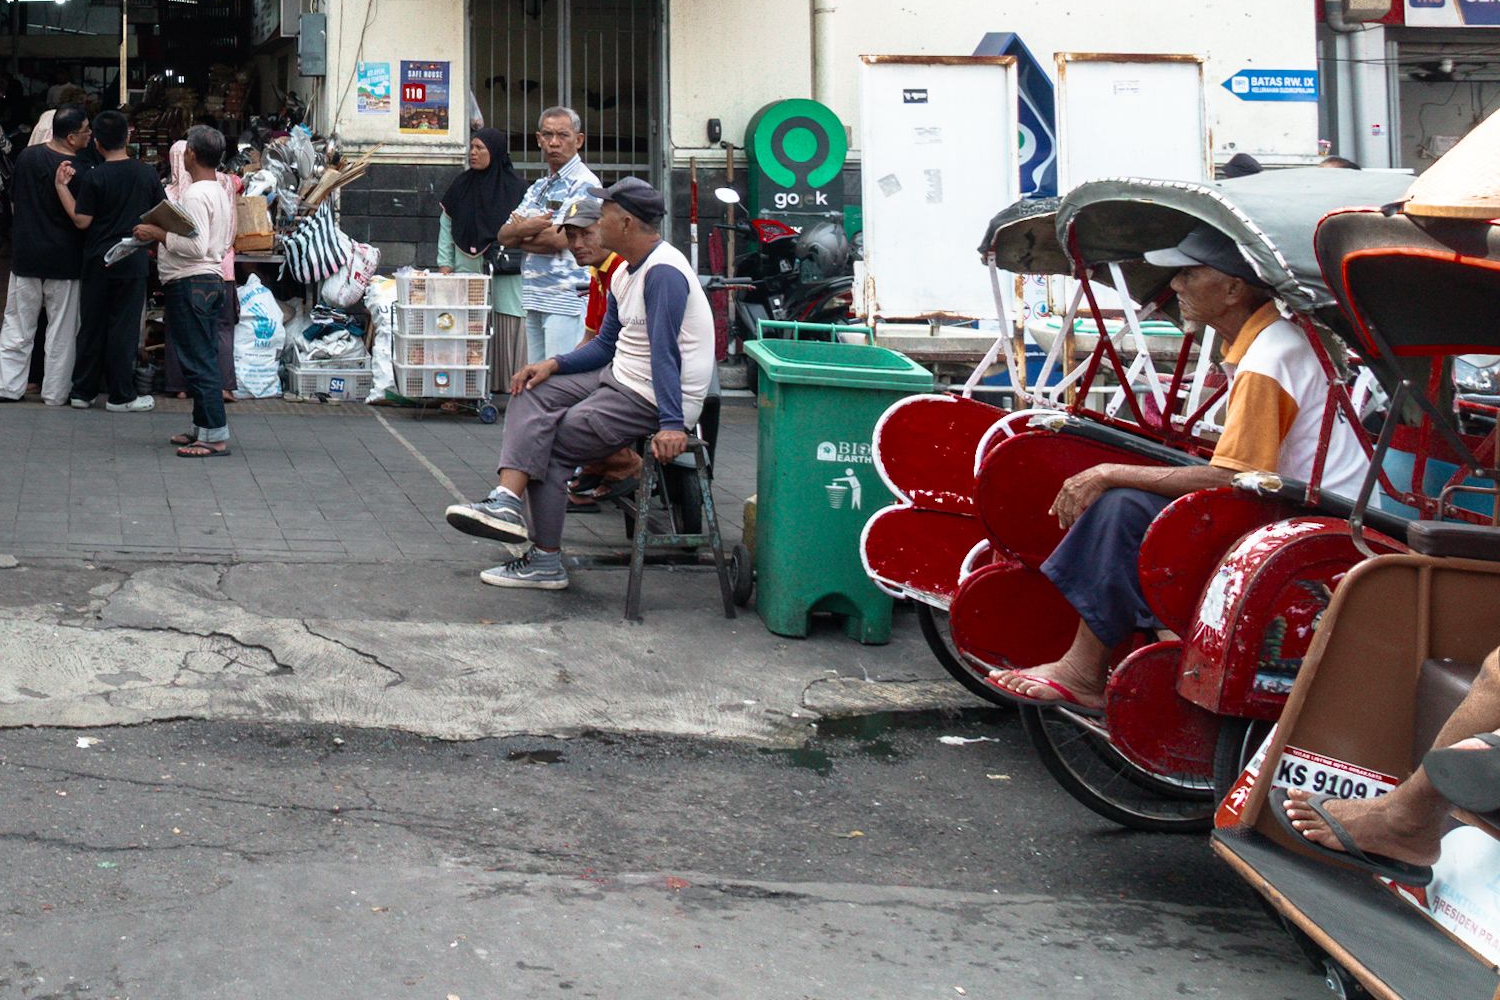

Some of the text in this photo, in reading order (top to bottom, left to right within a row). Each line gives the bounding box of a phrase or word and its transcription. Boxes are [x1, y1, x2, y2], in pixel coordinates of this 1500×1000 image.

[407, 70, 443, 79] SAFE HOUSE
[1250, 76, 1315, 87] BATAS RW. IX
[405, 87, 423, 99] 110
[329, 379, 345, 391] SH
[836, 454, 873, 464] EARTH
[1277, 760, 1368, 800] KS 9109
